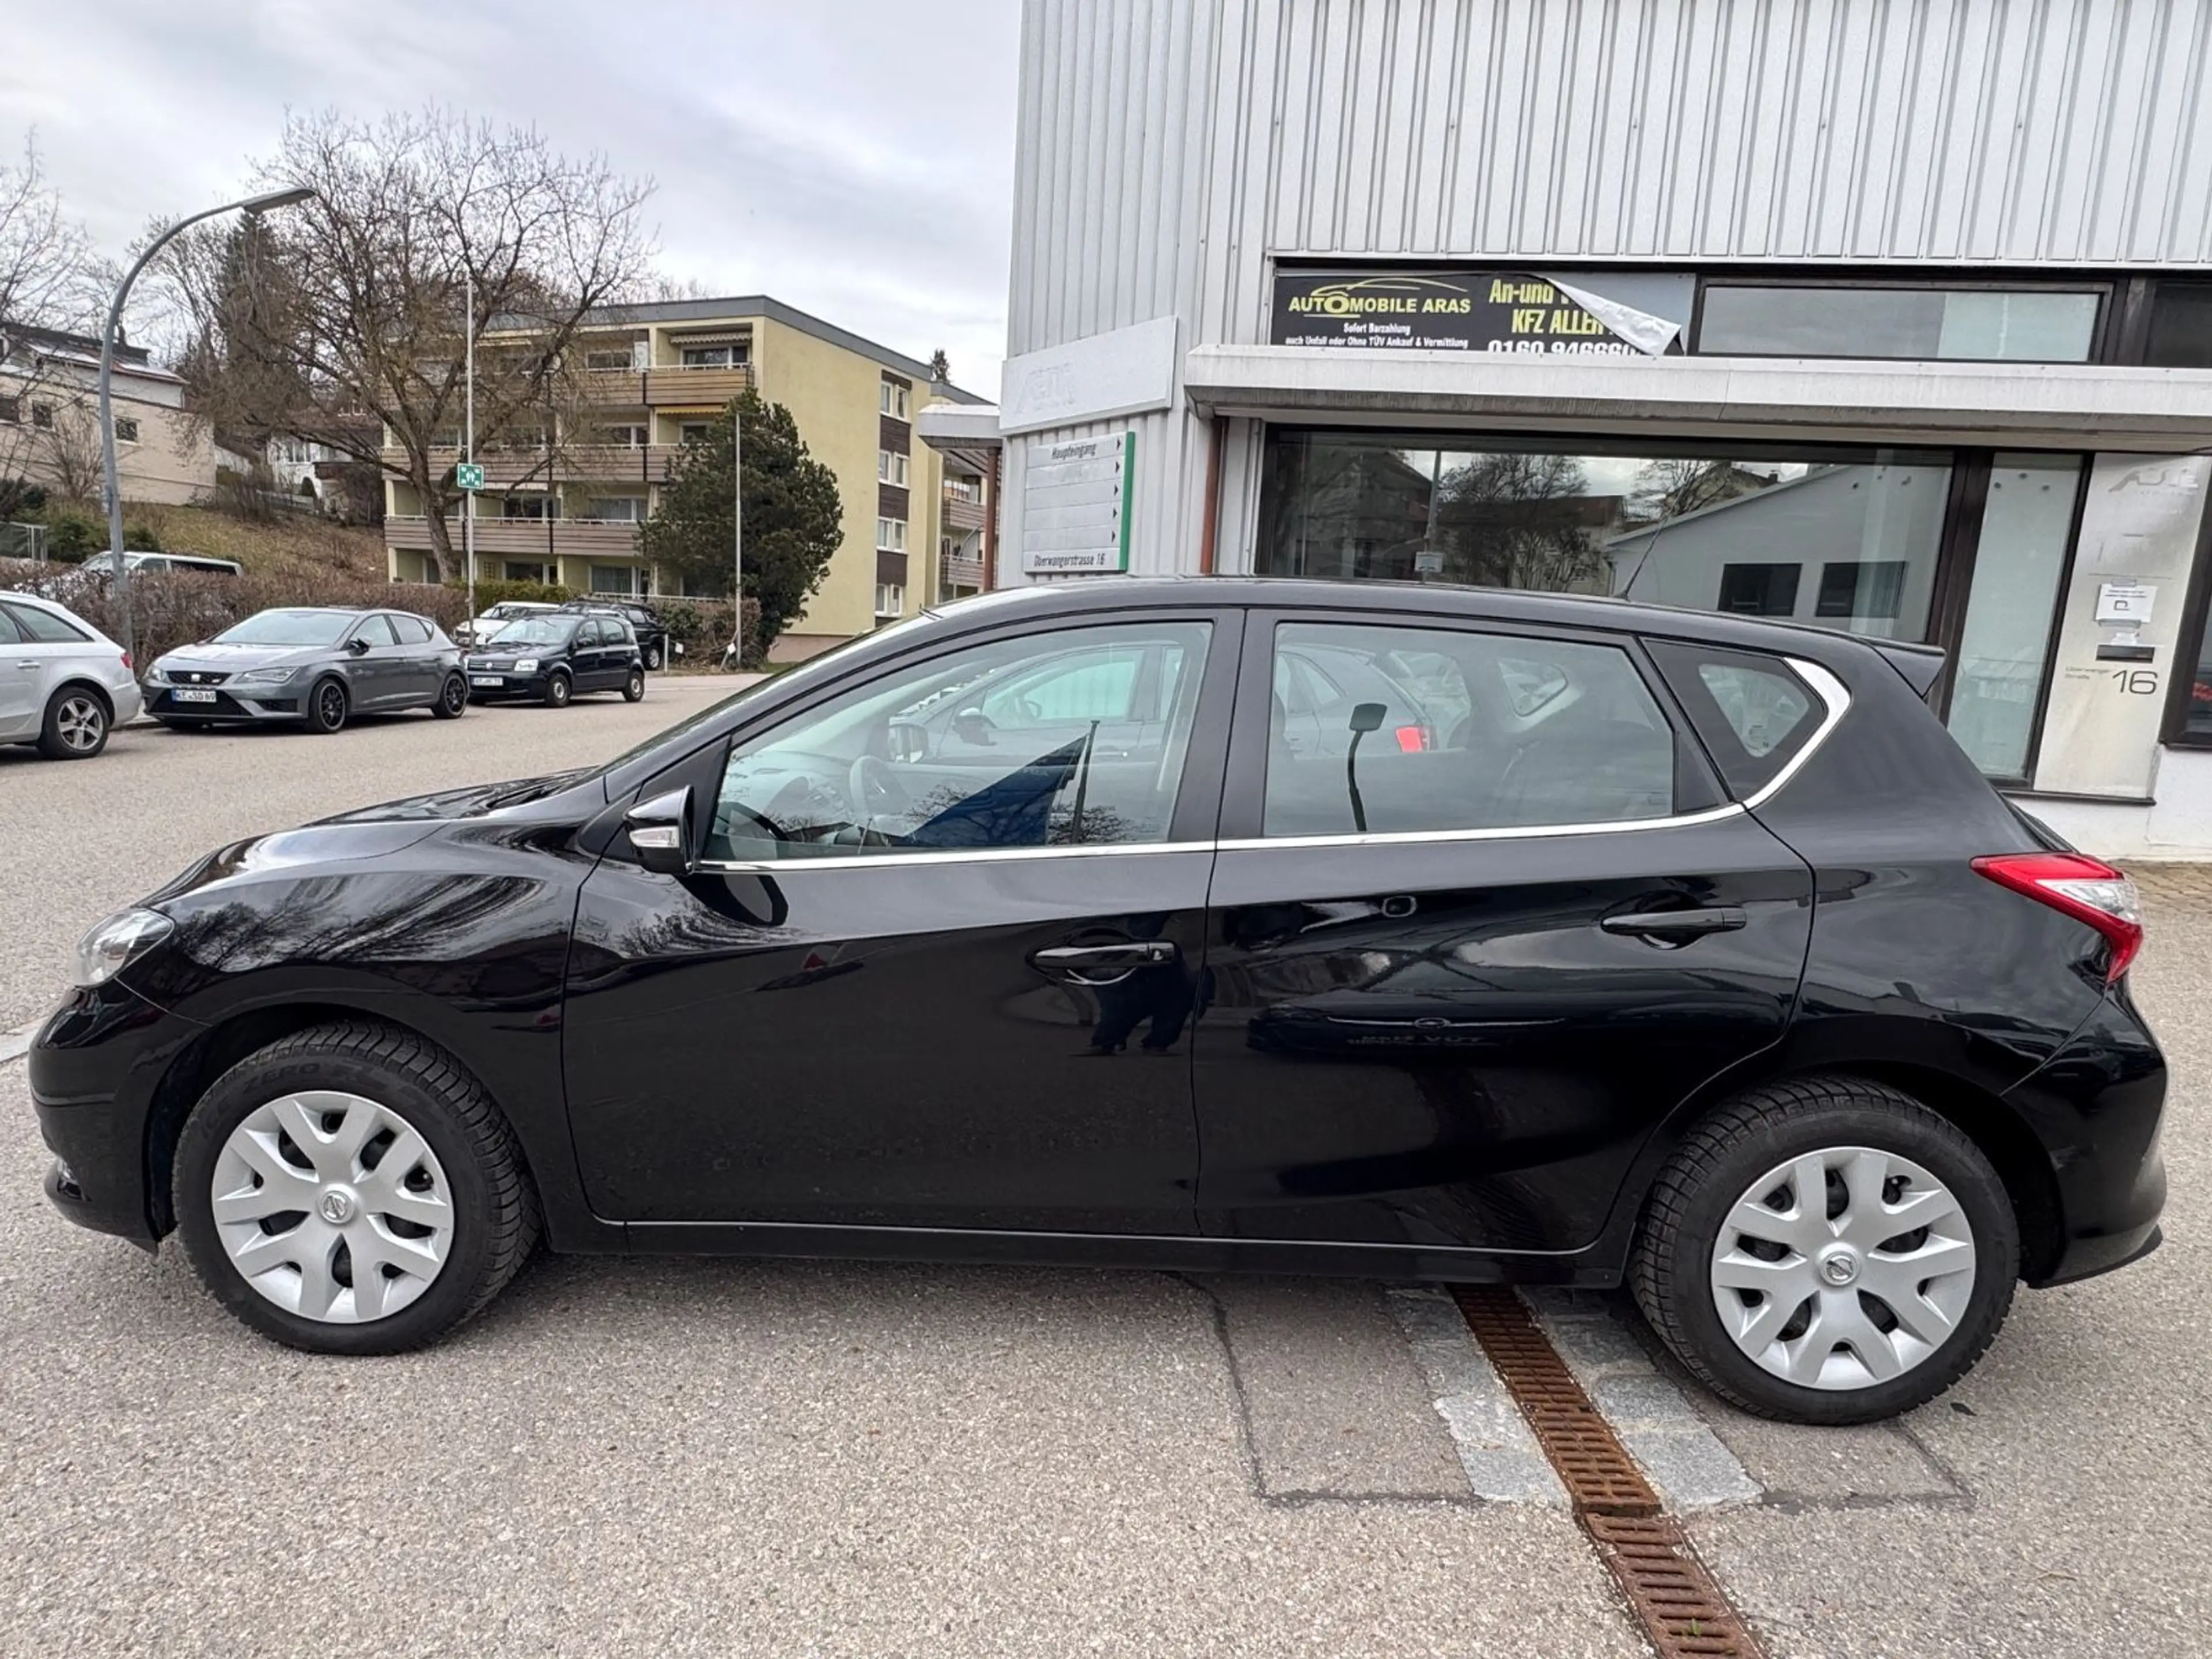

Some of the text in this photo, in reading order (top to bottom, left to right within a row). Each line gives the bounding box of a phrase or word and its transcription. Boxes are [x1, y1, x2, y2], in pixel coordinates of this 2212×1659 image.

[1288, 296, 1471, 313] AUTOMOBILE ARAS
[1343, 322, 1411, 336] Sofort Barzahlung
[1512, 309, 1546, 334] KFZ
[1305, 336, 1327, 345] Unfall
[1328, 336, 1346, 345] oder
[1347, 336, 1367, 346] Ohne
[1369, 335, 1385, 346] TÜV
[1387, 336, 1414, 346] Ankauf
[1415, 336, 1422, 347] &
[1424, 337, 1469, 349] Vermittlung
[2112, 669, 2158, 695] 16
